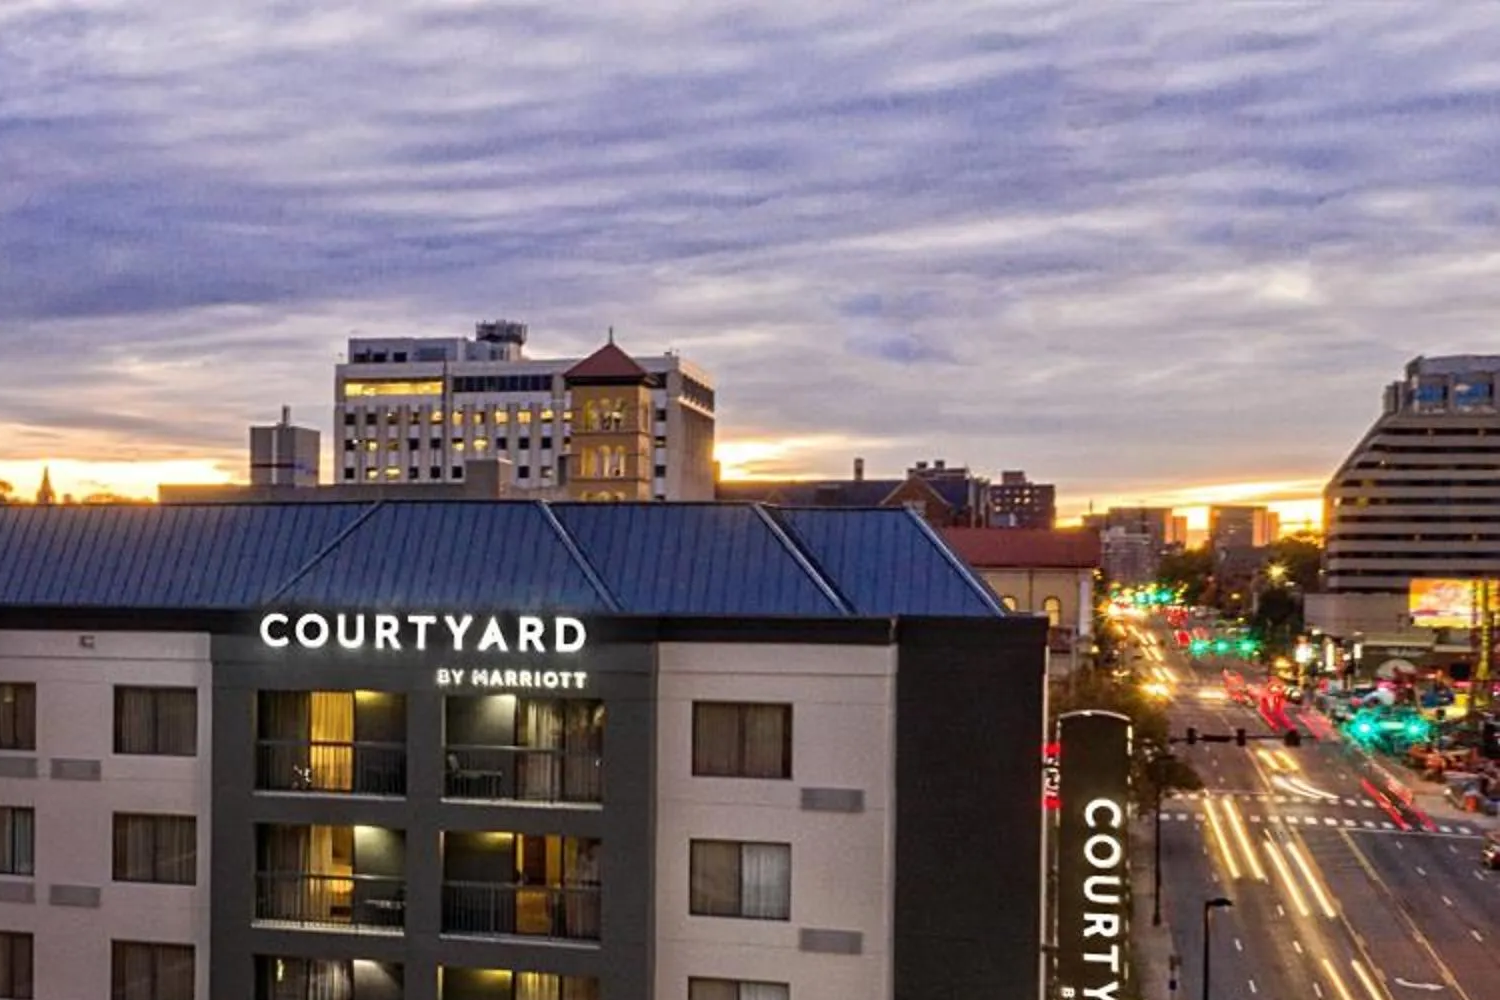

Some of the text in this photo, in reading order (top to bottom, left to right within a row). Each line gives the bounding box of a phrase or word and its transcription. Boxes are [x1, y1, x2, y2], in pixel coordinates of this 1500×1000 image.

[260, 613, 587, 652] COURTYARD
[436, 668, 588, 689] BY MARRIOTT
